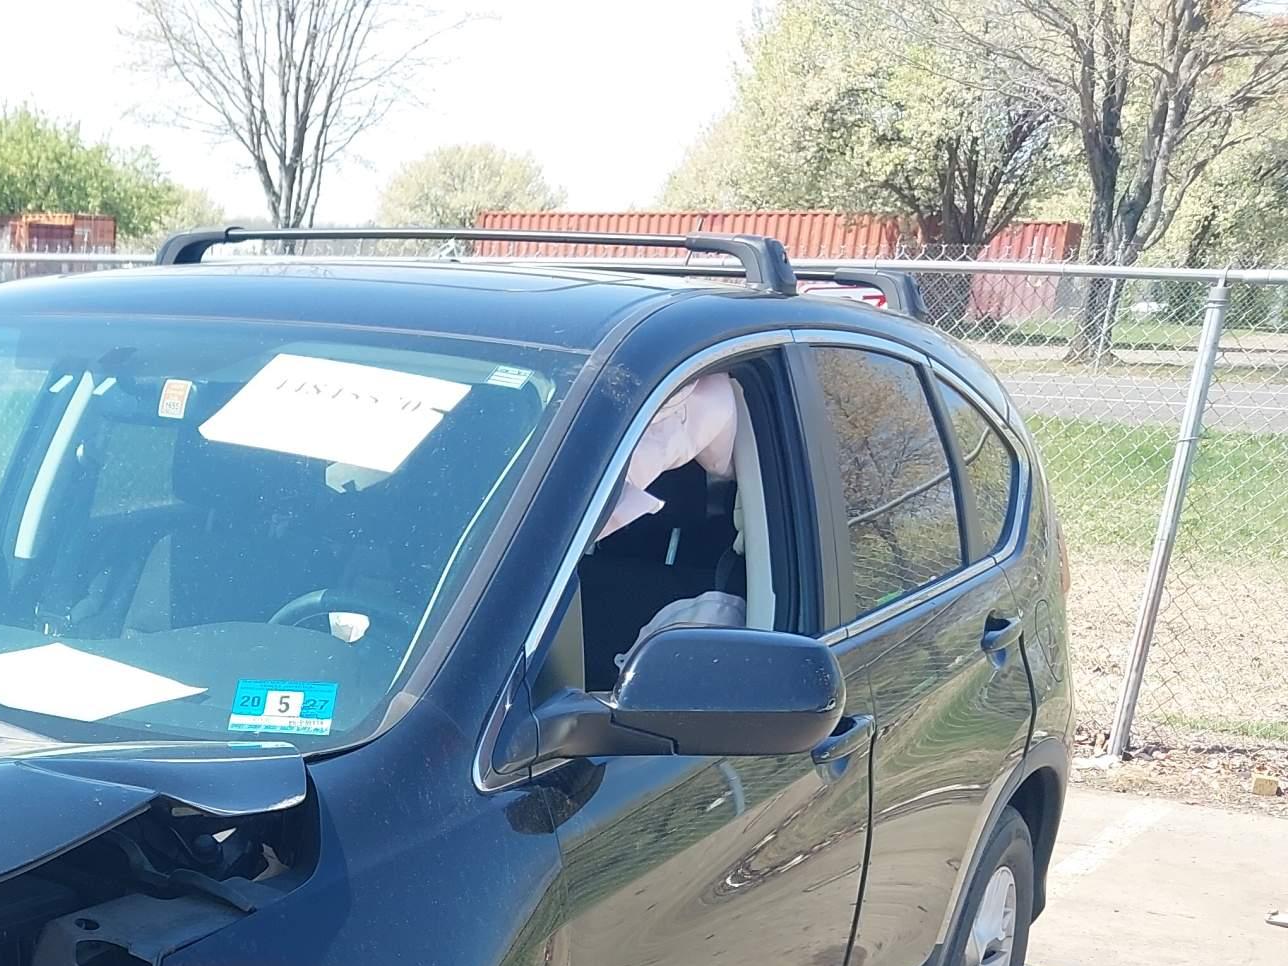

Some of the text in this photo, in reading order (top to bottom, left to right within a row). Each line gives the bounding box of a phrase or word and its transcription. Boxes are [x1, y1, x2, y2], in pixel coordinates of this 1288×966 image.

[239, 694, 330, 714] 20 5 27
